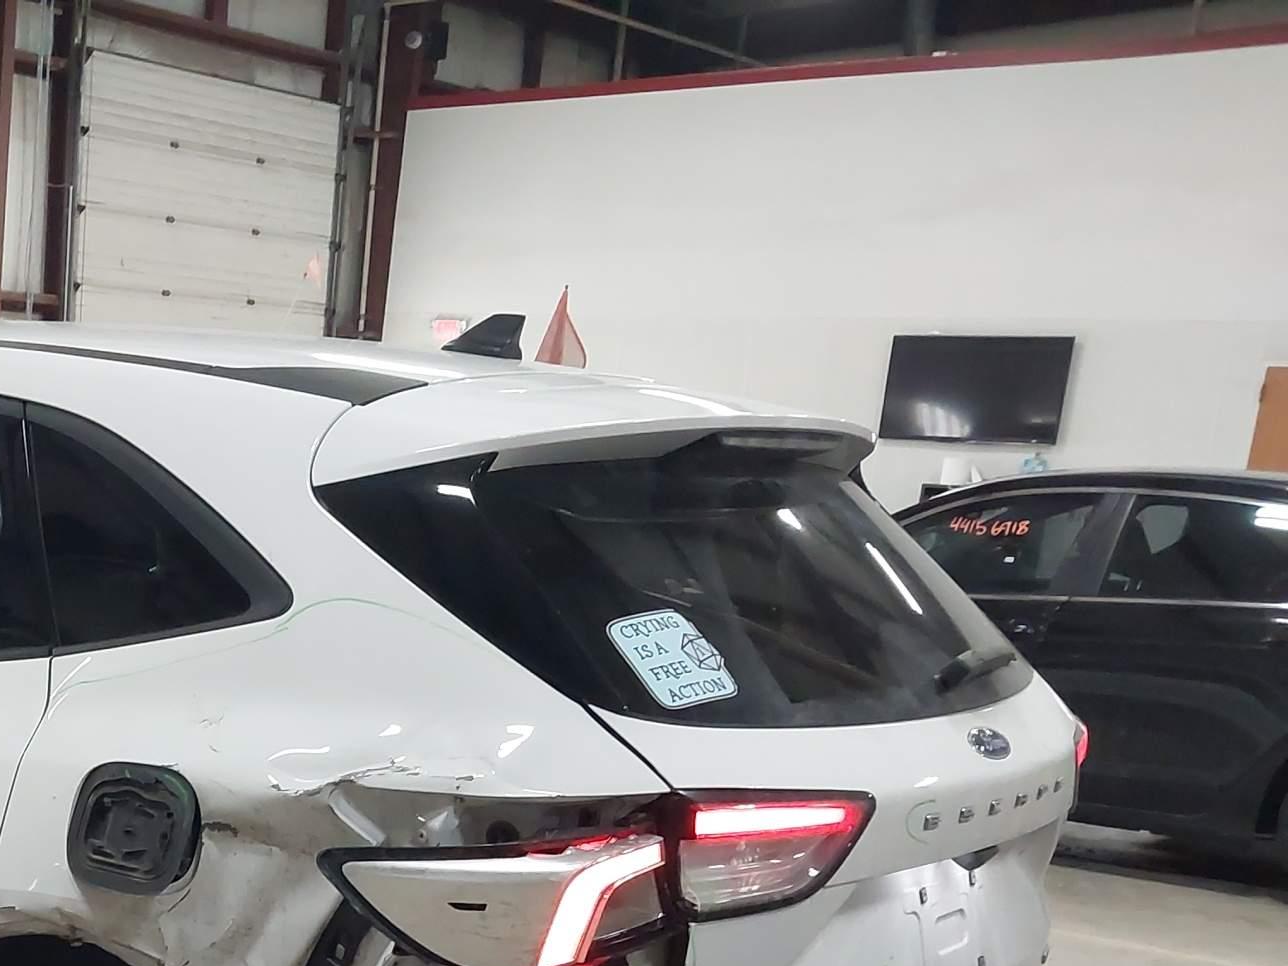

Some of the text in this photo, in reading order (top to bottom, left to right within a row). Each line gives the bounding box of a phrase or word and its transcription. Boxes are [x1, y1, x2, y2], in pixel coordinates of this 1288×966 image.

[619, 615, 680, 639] CRYING
[633, 641, 670, 660] IS A
[648, 660, 692, 681] FREE
[667, 677, 727, 702] ACTION
